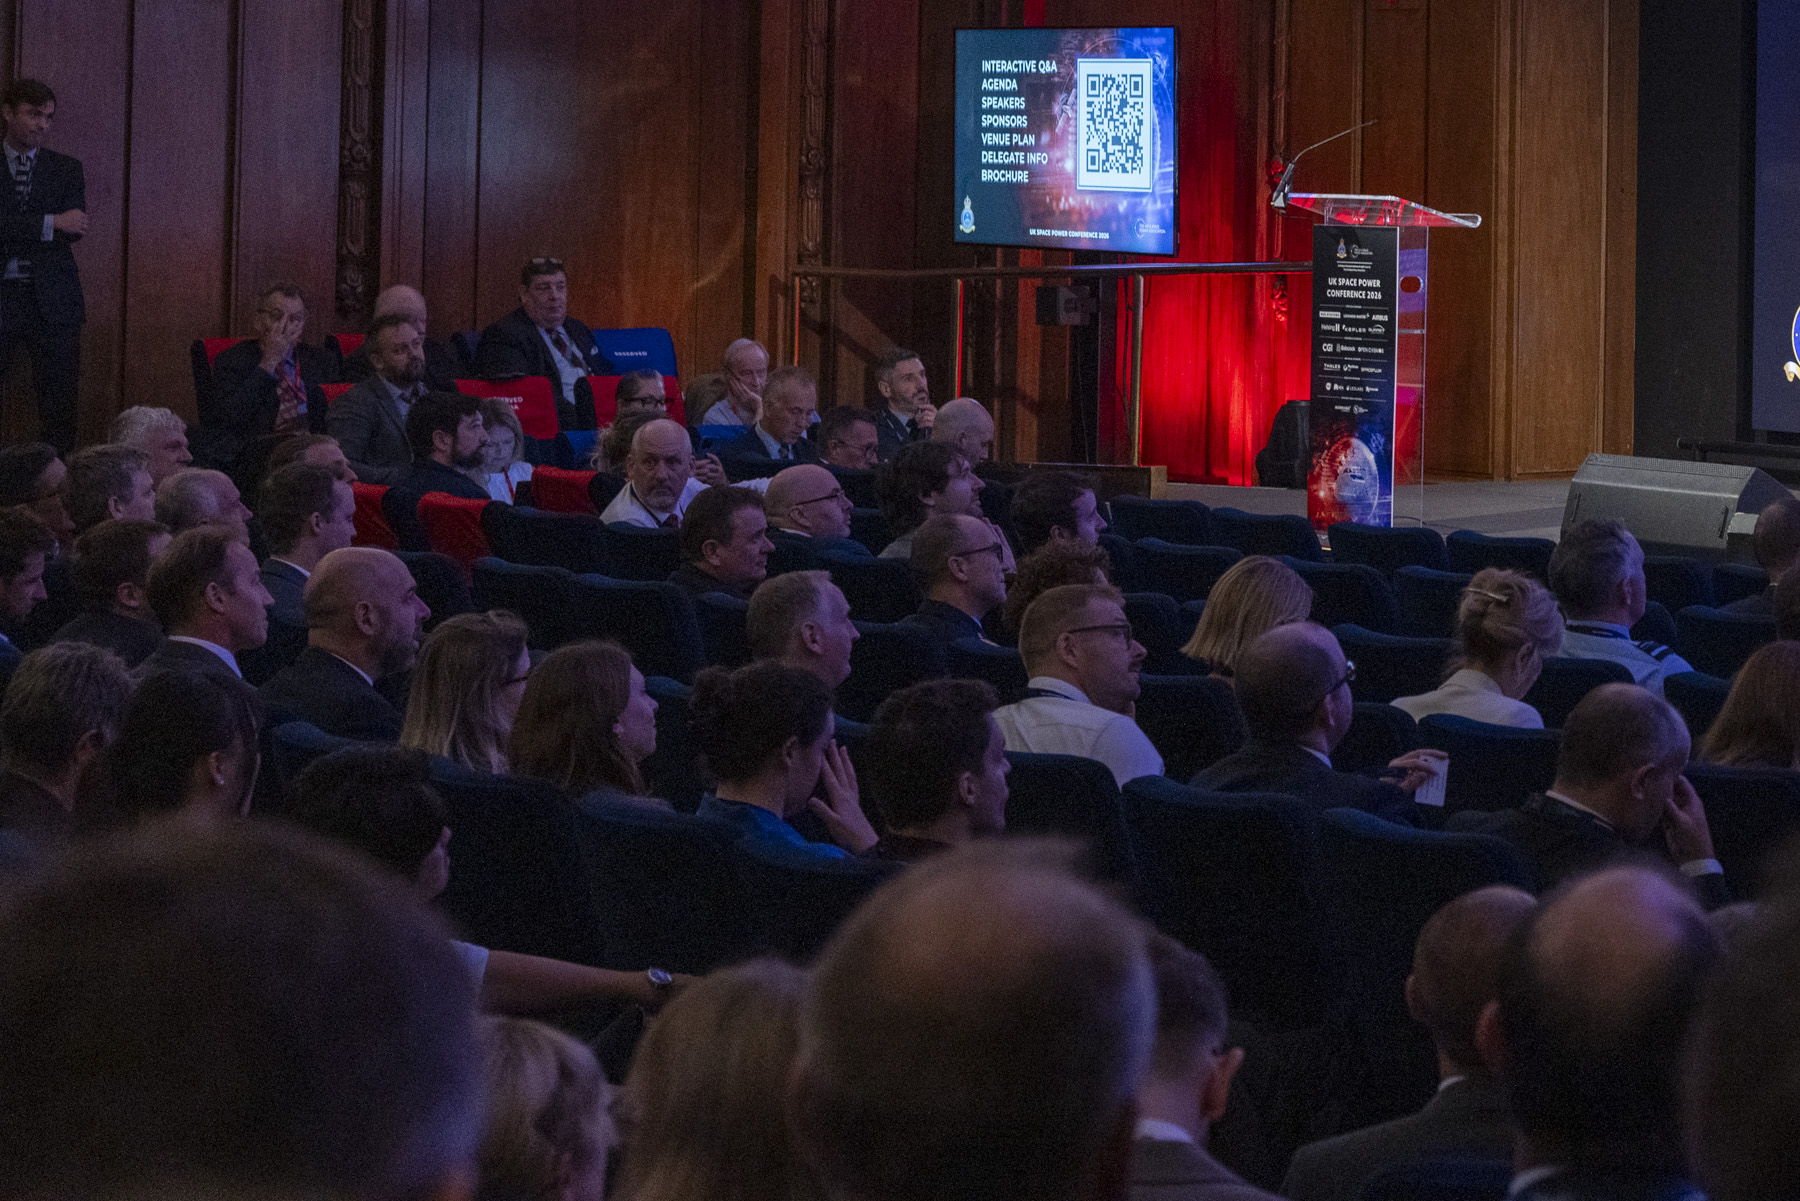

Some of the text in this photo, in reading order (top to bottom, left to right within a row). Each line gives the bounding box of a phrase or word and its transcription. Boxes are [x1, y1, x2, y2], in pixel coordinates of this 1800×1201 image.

[982, 60, 1058, 74] INTERACTIVE Q&A
[982, 78, 1018, 91] AGENDA
[982, 96, 1025, 110] SPEAKERS
[982, 115, 1028, 128] SPONSORS
[982, 133, 1035, 146] VENUE PLAN
[982, 152, 1048, 164] DELEGATE INFO
[982, 170, 1028, 183] BROCHURE
[1328, 278, 1380, 288] UK SPACE POWER
[1327, 290, 1382, 300] CONFERENCE 2026
